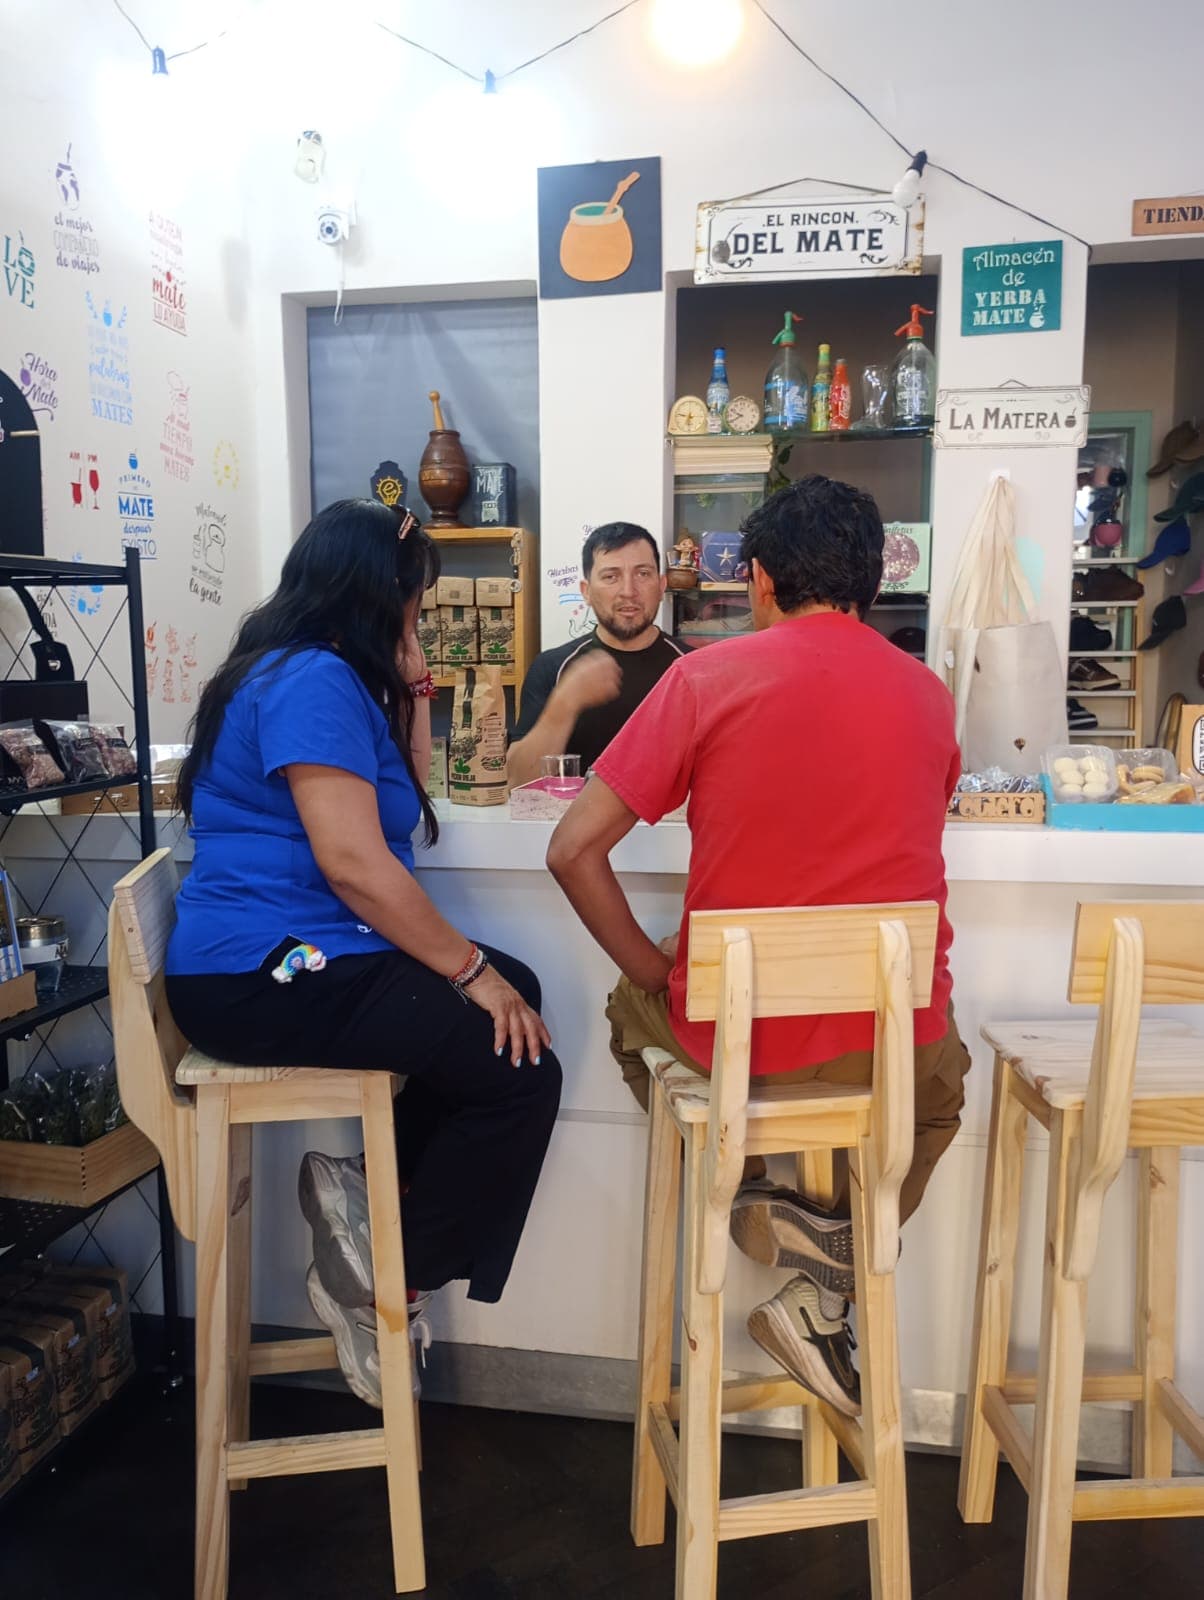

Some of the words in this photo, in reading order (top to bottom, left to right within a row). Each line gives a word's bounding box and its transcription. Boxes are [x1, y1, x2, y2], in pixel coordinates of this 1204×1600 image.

[1143, 206, 1204, 224] TIEND
[733, 232, 784, 255] DEL
[796, 228, 883, 254] MATE
[56, 249, 68, 268] de
[1002, 268, 1026, 287] de
[152, 276, 186, 310] mate
[975, 288, 1047, 307] YERBA
[973, 308, 1026, 326] MATE
[91, 398, 134, 426] MATES
[982, 407, 1061, 430] MATERA
[118, 495, 154, 518] MATE
